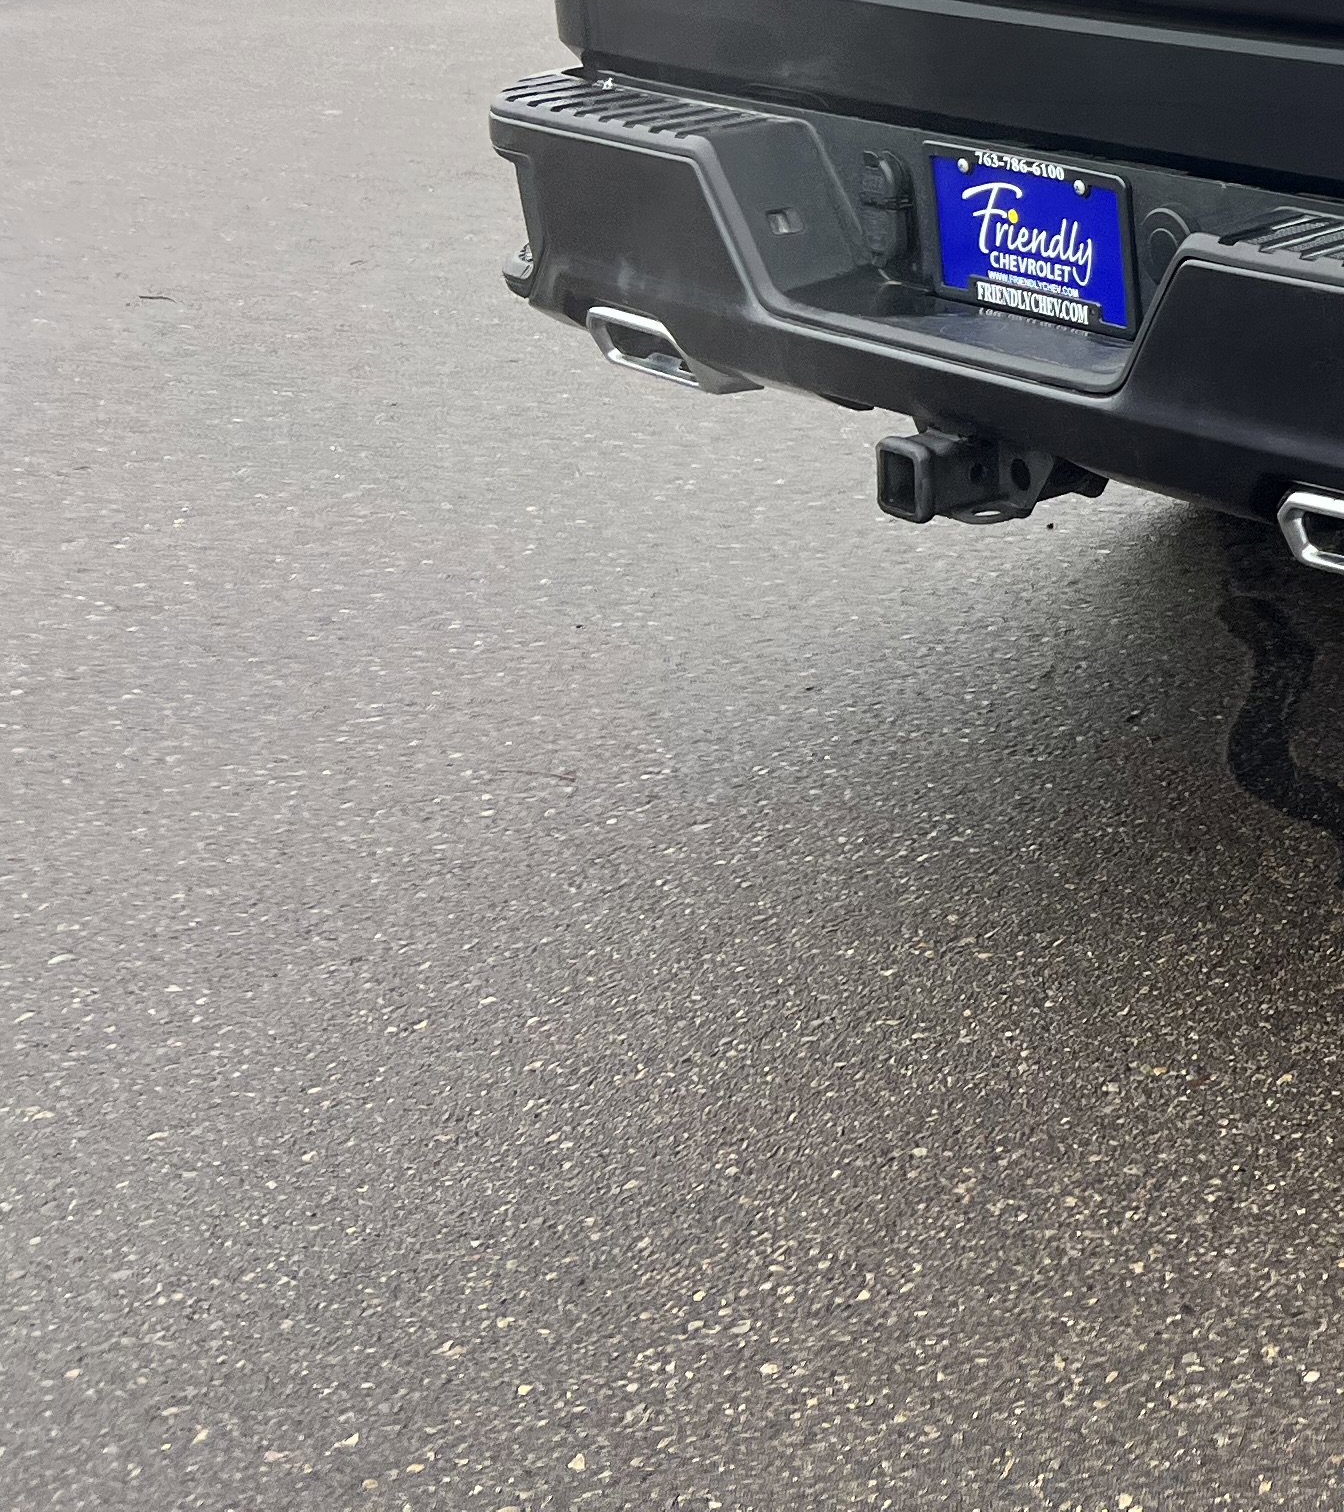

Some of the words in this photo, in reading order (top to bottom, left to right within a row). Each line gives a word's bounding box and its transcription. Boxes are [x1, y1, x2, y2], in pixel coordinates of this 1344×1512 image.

[974, 151, 1065, 179] 763-786-6100
[961, 182, 1093, 286] Friendly
[989, 251, 1071, 283] CHEVROLET
[976, 281, 1089, 325] FRIENDLYCHEV.COM
